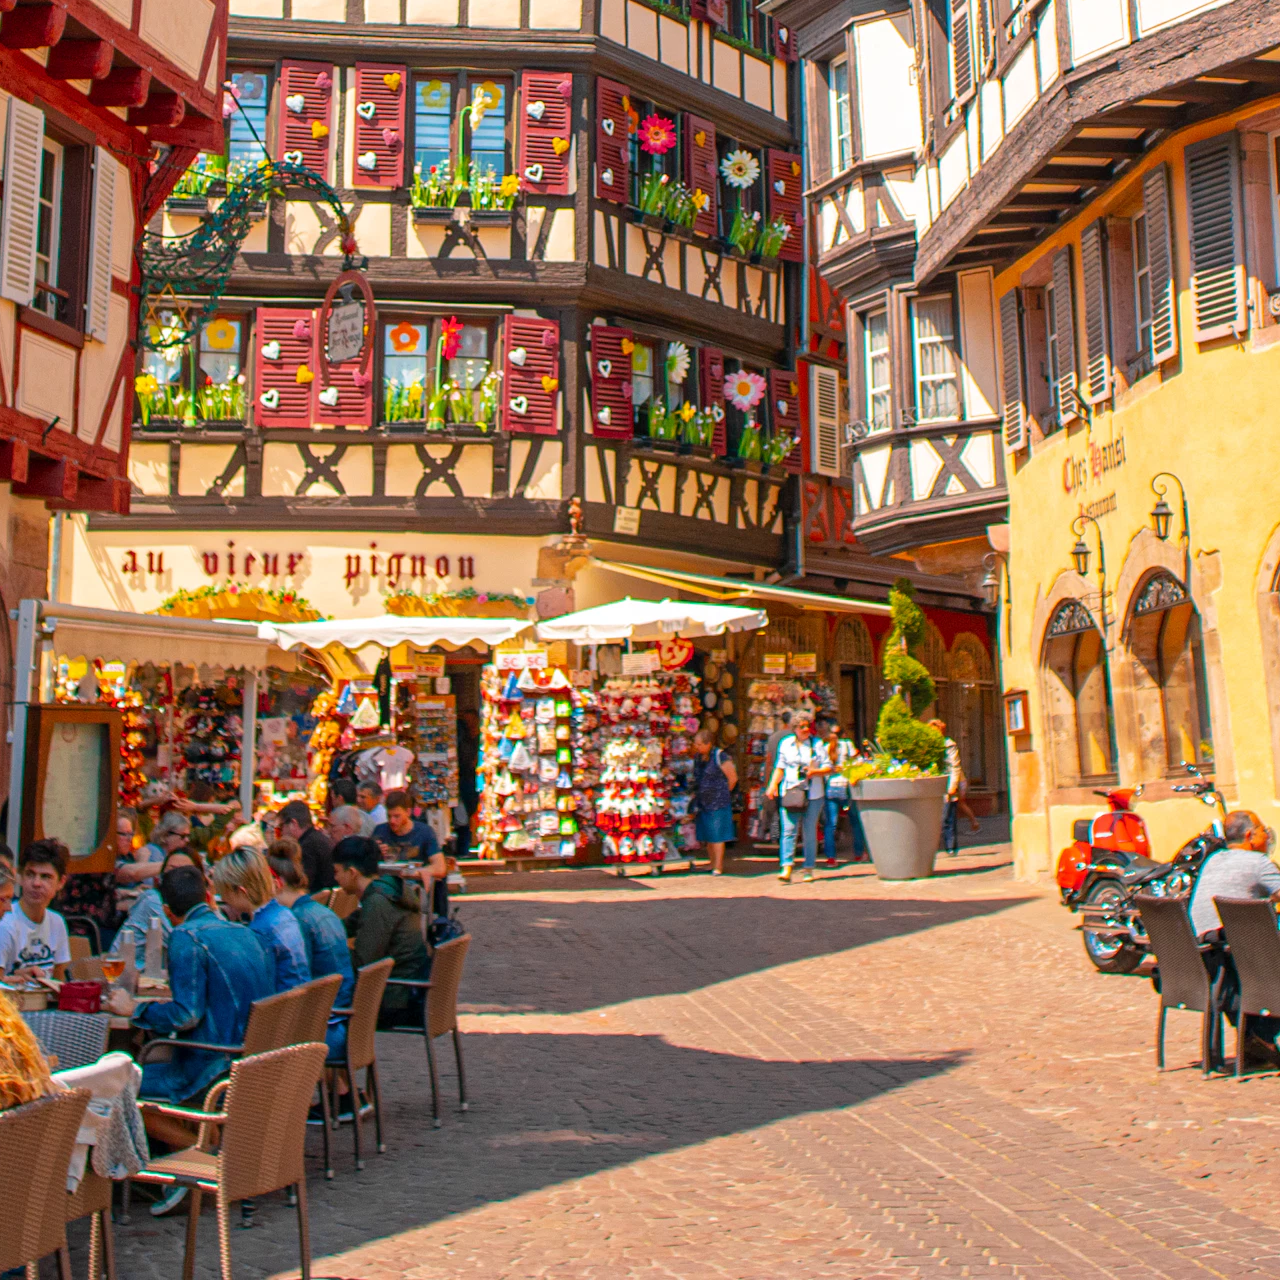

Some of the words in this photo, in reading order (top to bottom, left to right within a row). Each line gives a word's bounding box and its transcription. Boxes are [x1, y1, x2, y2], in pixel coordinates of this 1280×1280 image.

[122, 549, 165, 576] au
[202, 539, 305, 577] vieux
[343, 540, 476, 589] pignon
